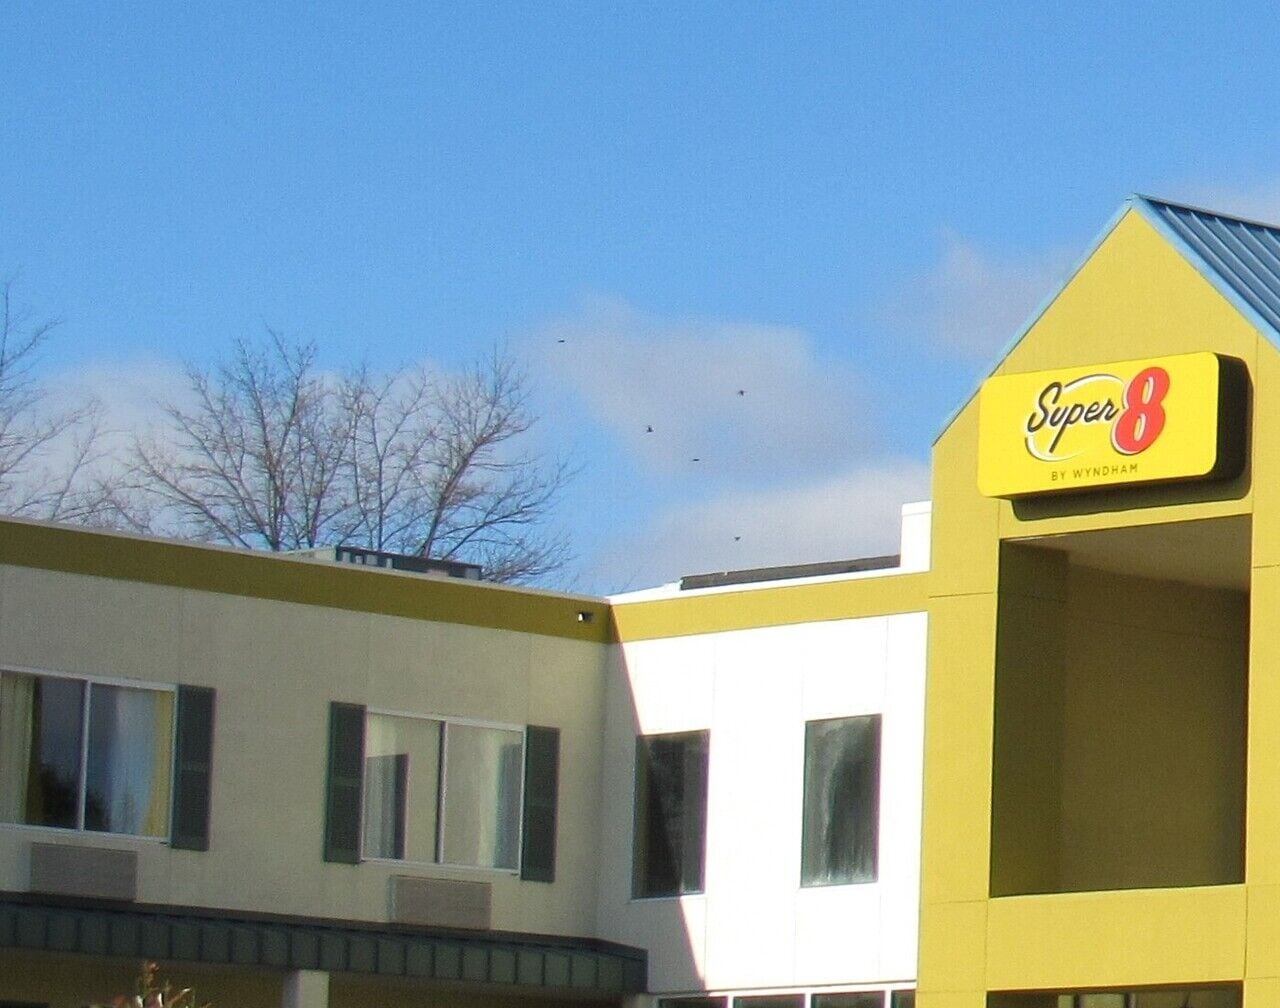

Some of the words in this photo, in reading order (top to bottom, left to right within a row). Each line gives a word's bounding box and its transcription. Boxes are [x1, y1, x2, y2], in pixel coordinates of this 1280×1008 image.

[1026, 381, 1119, 454] Super
[1111, 366, 1171, 456] 8
[1051, 470, 1068, 482] BY
[1072, 462, 1139, 480] WYNDHAM
